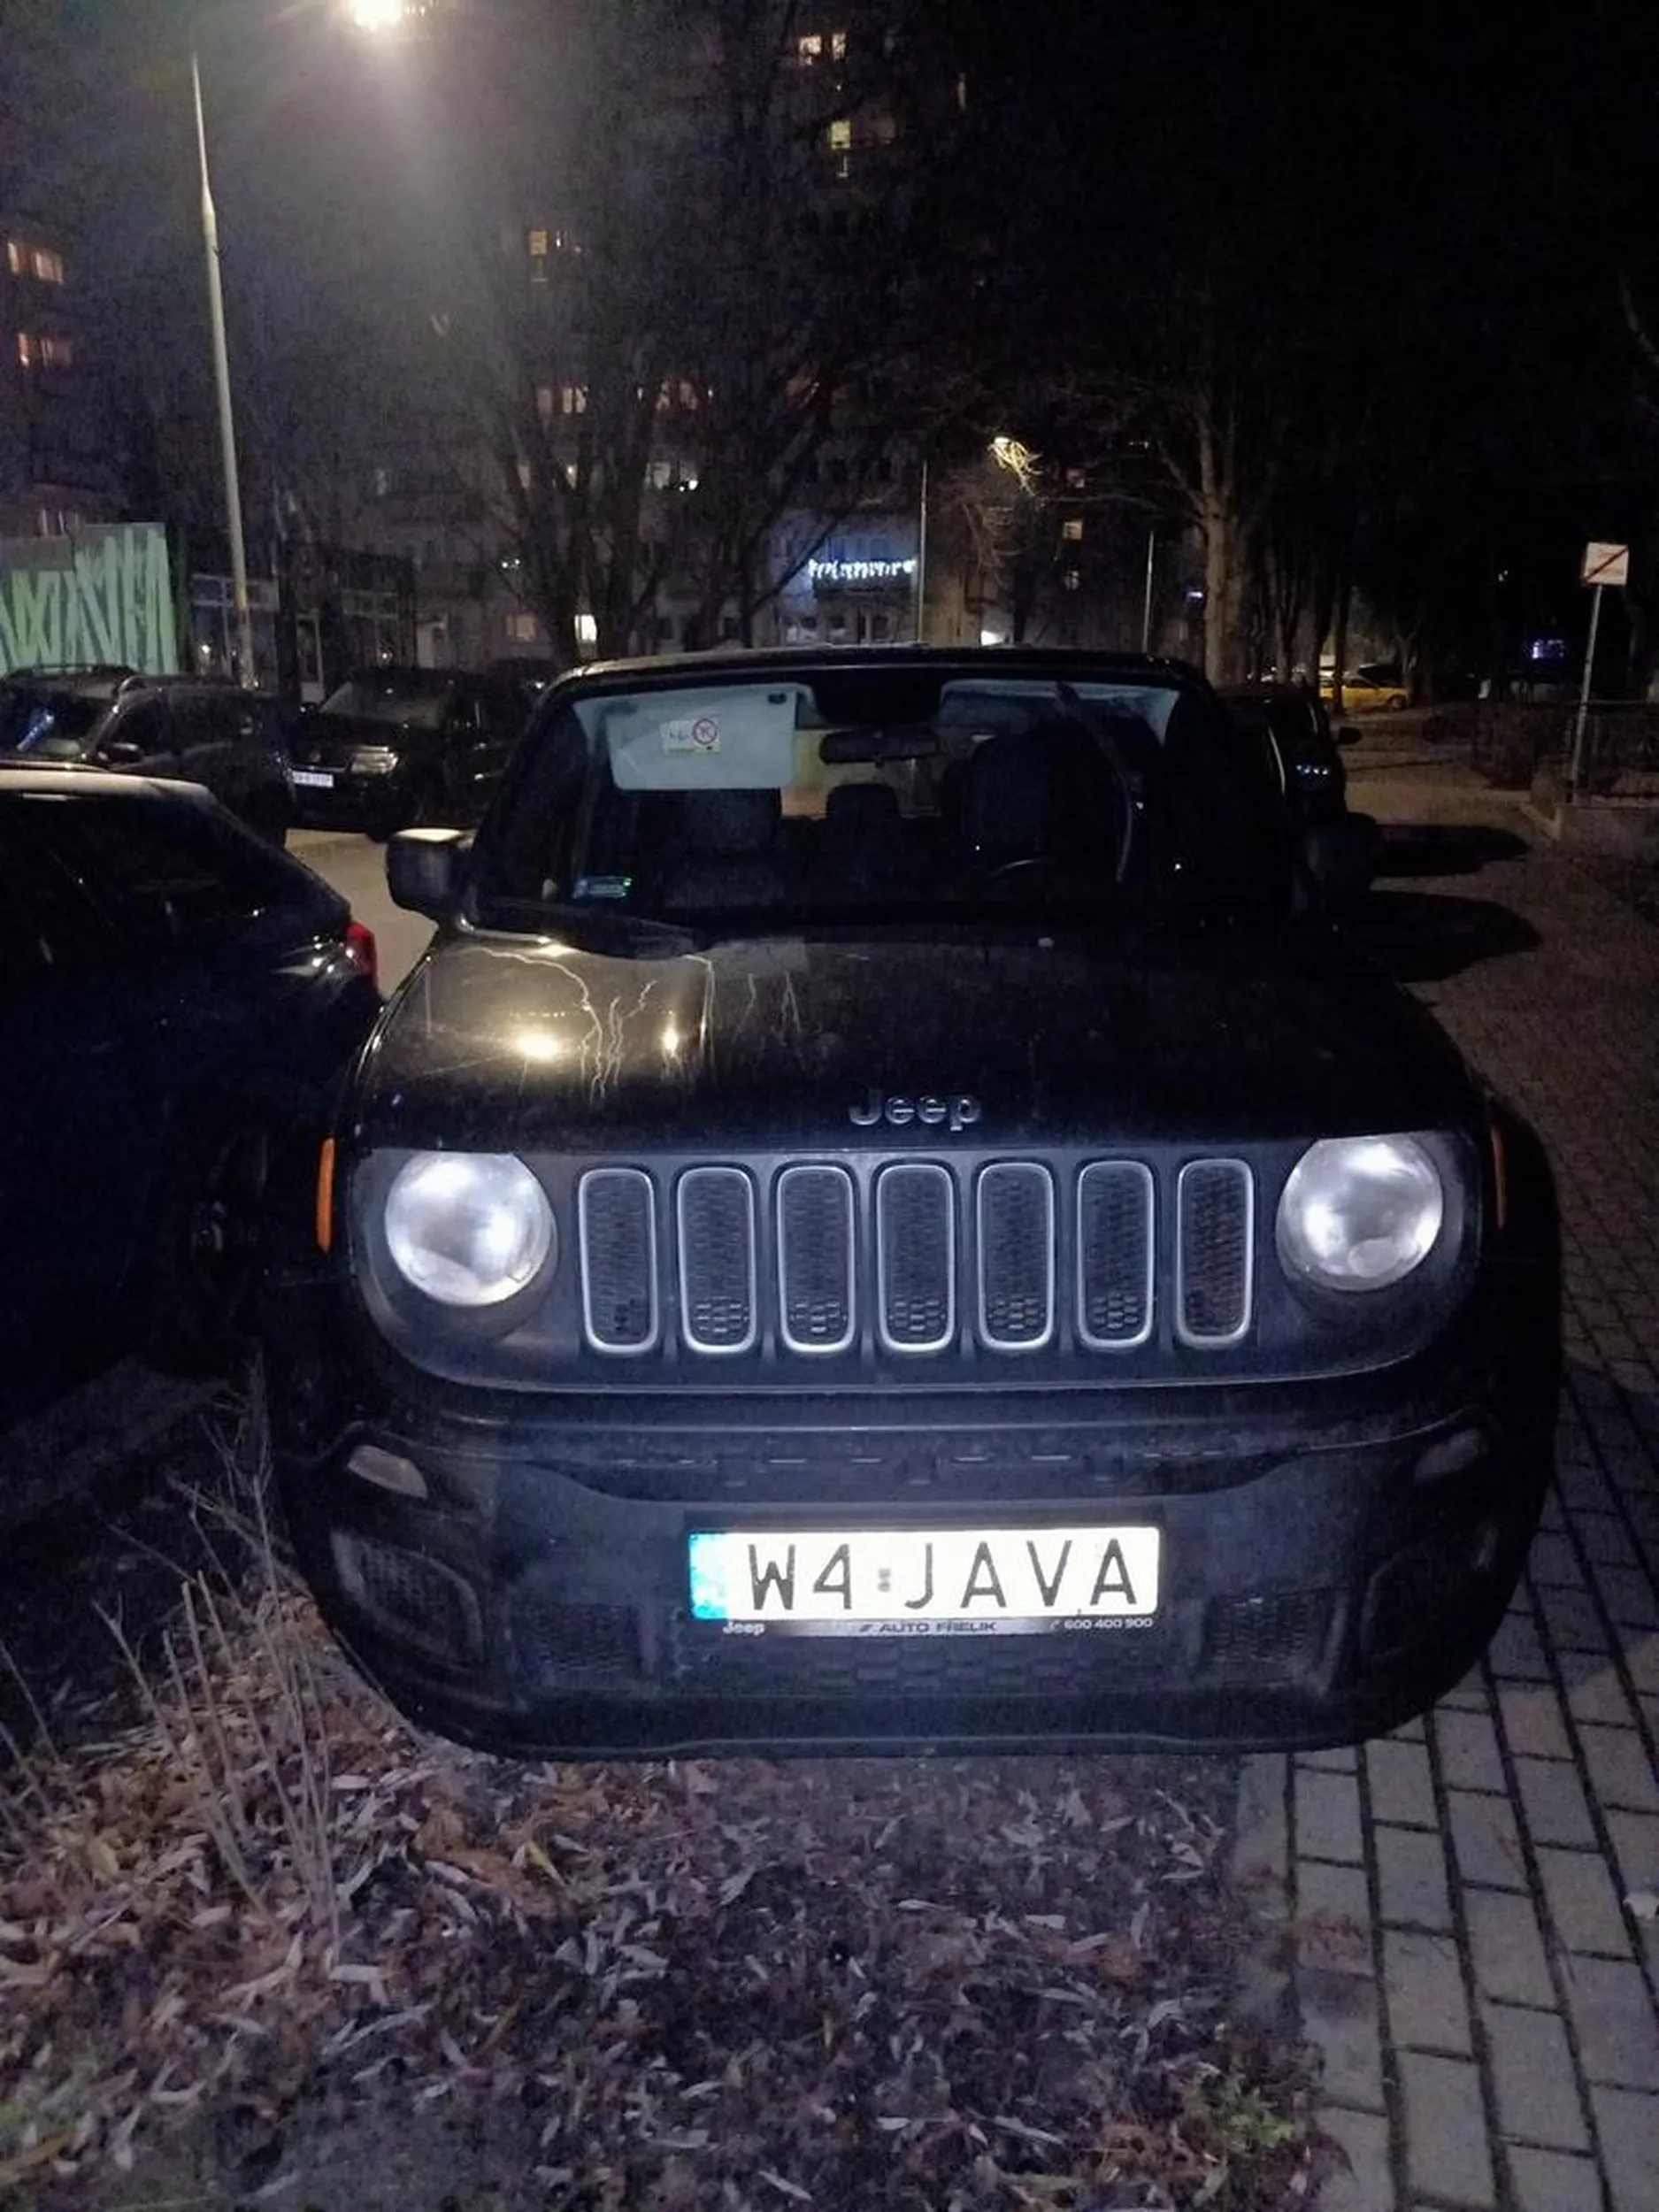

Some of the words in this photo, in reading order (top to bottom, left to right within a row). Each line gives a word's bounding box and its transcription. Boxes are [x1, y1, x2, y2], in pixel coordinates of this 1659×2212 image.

[848, 1088, 981, 1132] Jeep
[747, 1542, 853, 1611] W4
[903, 1538, 1138, 1610] JAVA
[722, 1621, 765, 1636] Jeep
[879, 1622, 930, 1632] AUTO
[1094, 1618, 1123, 1629] 400
